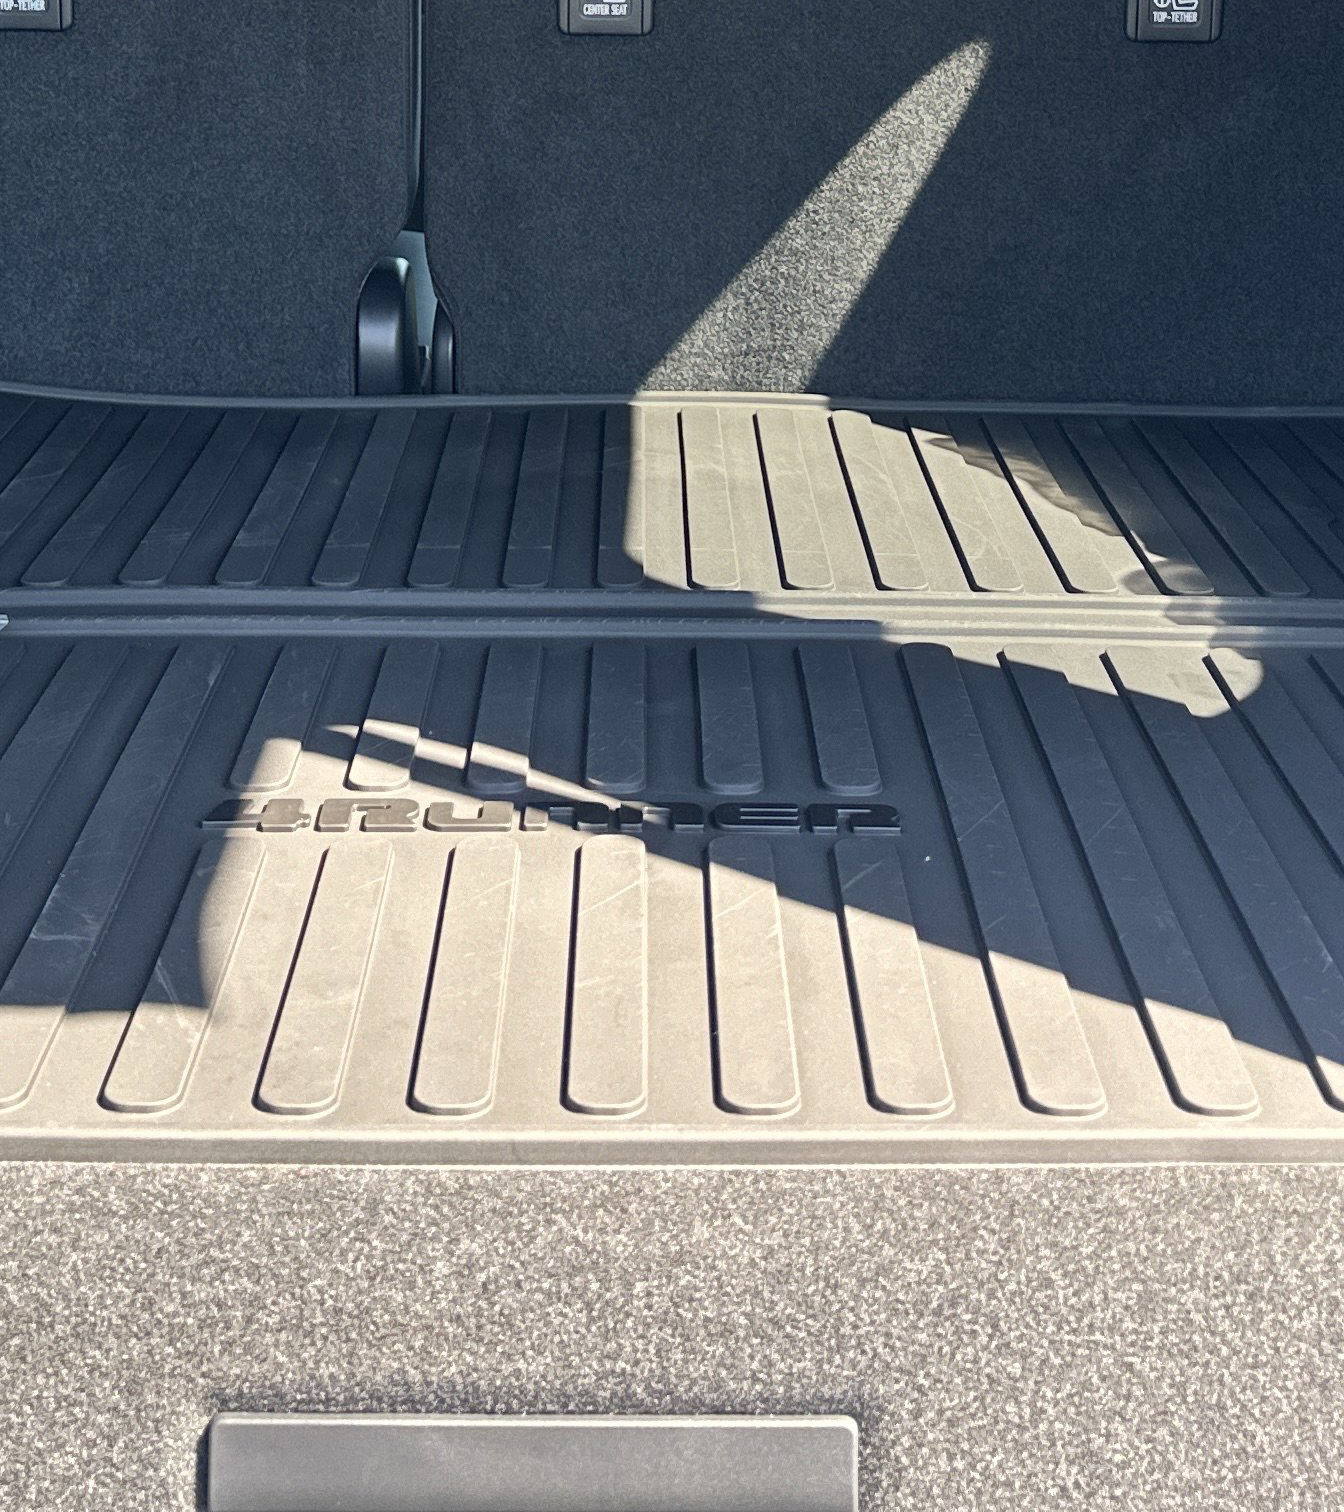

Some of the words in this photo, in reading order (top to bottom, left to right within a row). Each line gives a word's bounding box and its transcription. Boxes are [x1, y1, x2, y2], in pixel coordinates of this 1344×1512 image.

[582, 3, 610, 16] CENTER
[611, 3, 628, 16] SEAT
[1152, 10, 1198, 23] TOP-TETHER
